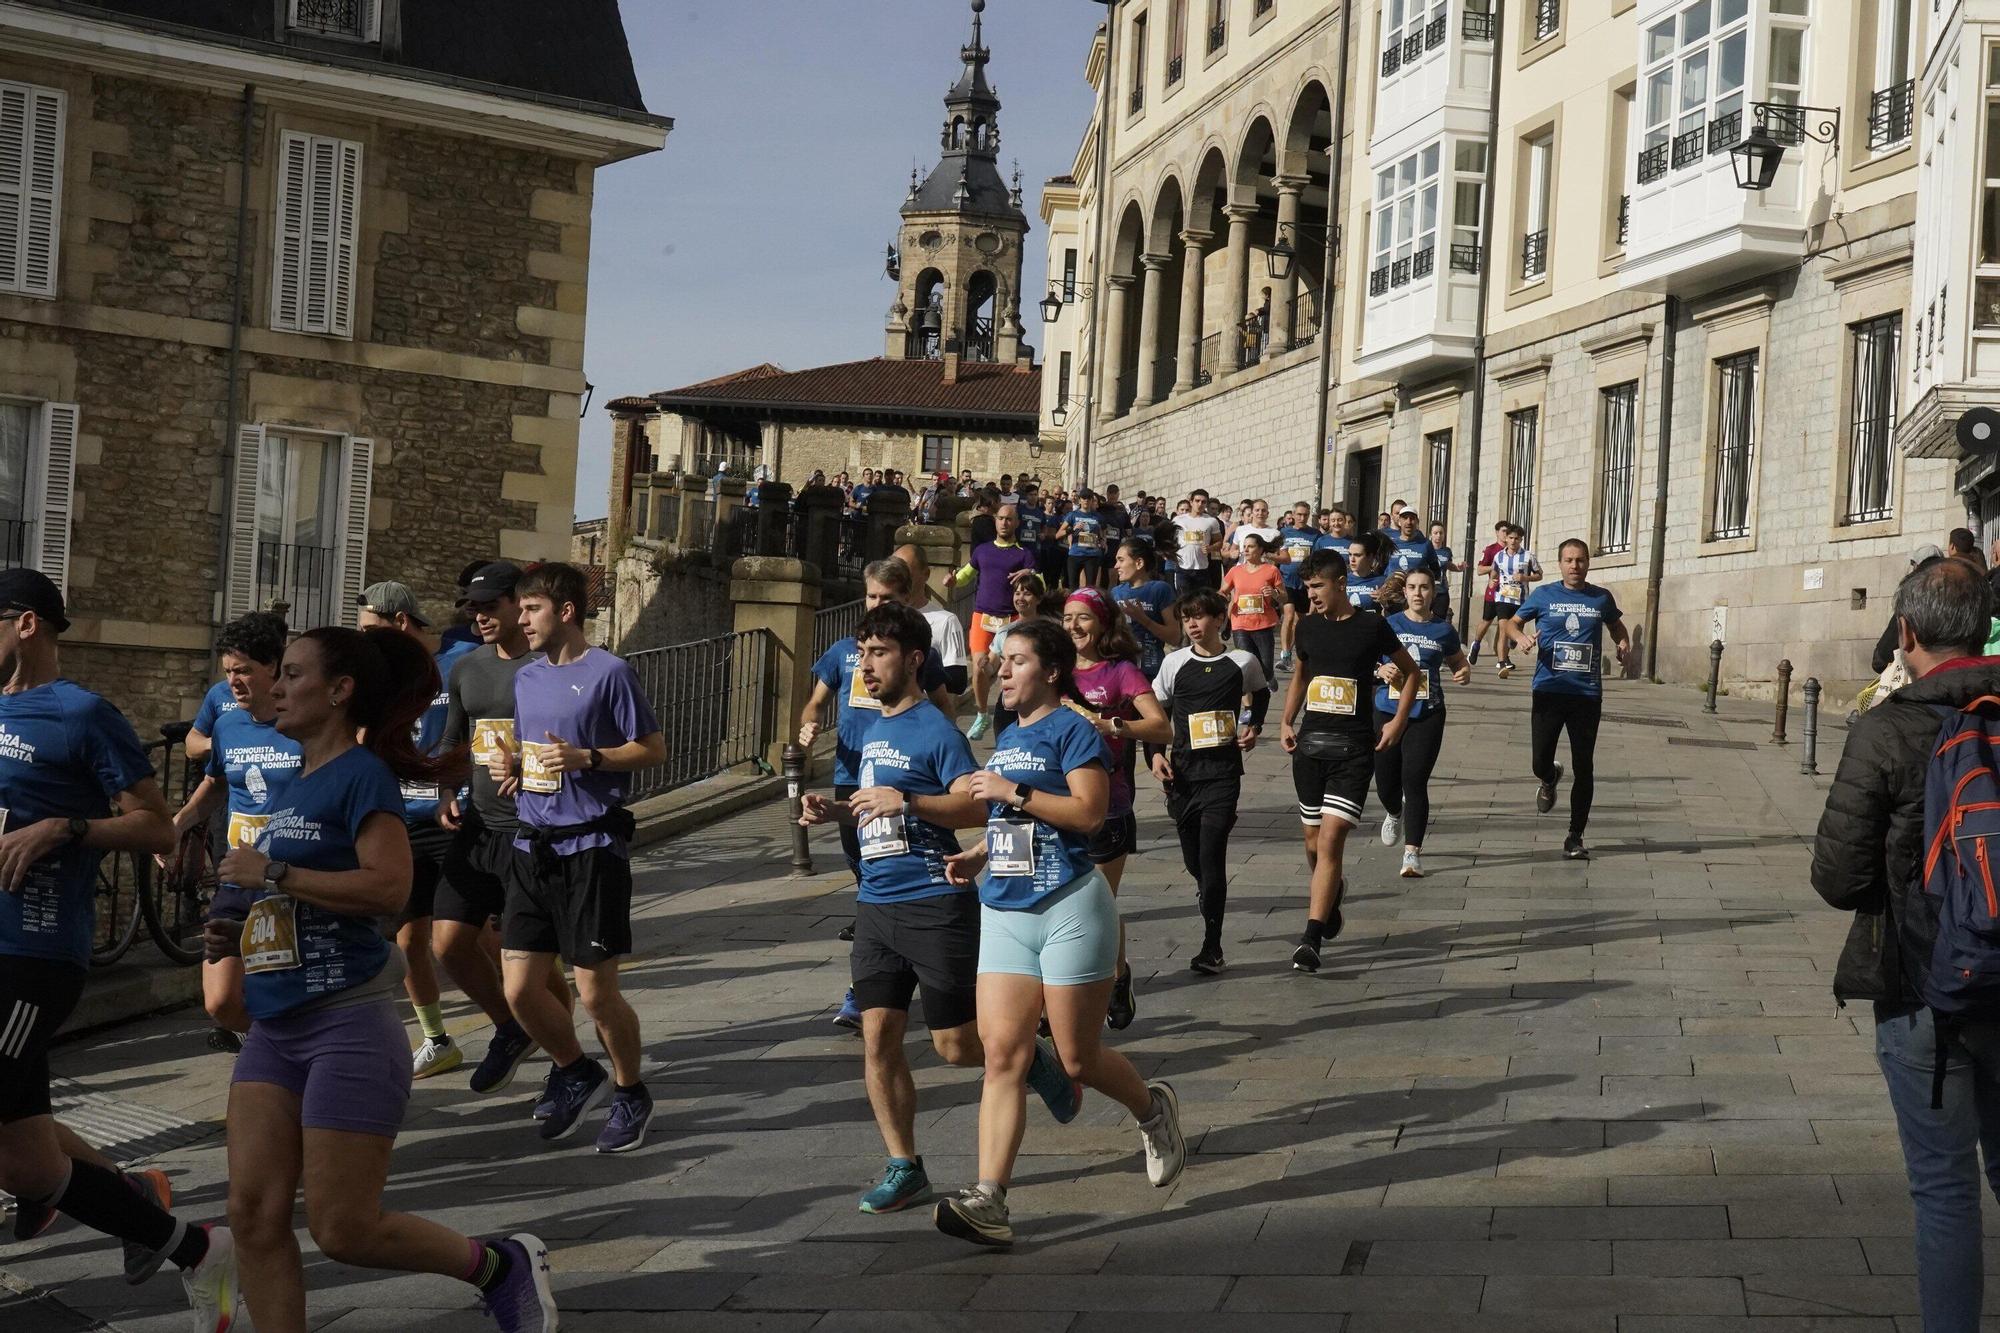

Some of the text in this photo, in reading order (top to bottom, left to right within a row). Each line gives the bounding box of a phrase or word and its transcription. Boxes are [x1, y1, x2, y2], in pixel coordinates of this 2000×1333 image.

[1564, 649, 1582, 660] 799
[1320, 685, 1344, 700] 649
[1203, 720, 1225, 734] 648
[20, 742, 35, 753] REN
[234, 746, 275, 755] CONQUISTA
[233, 752, 290, 764] ALMENDRA
[262, 760, 302, 769] KONKISTA
[1003, 762, 1046, 771] KONKISTA
[305, 821, 321, 830] REN
[992, 834, 1013, 853] 144
[250, 915, 275, 945] 504
